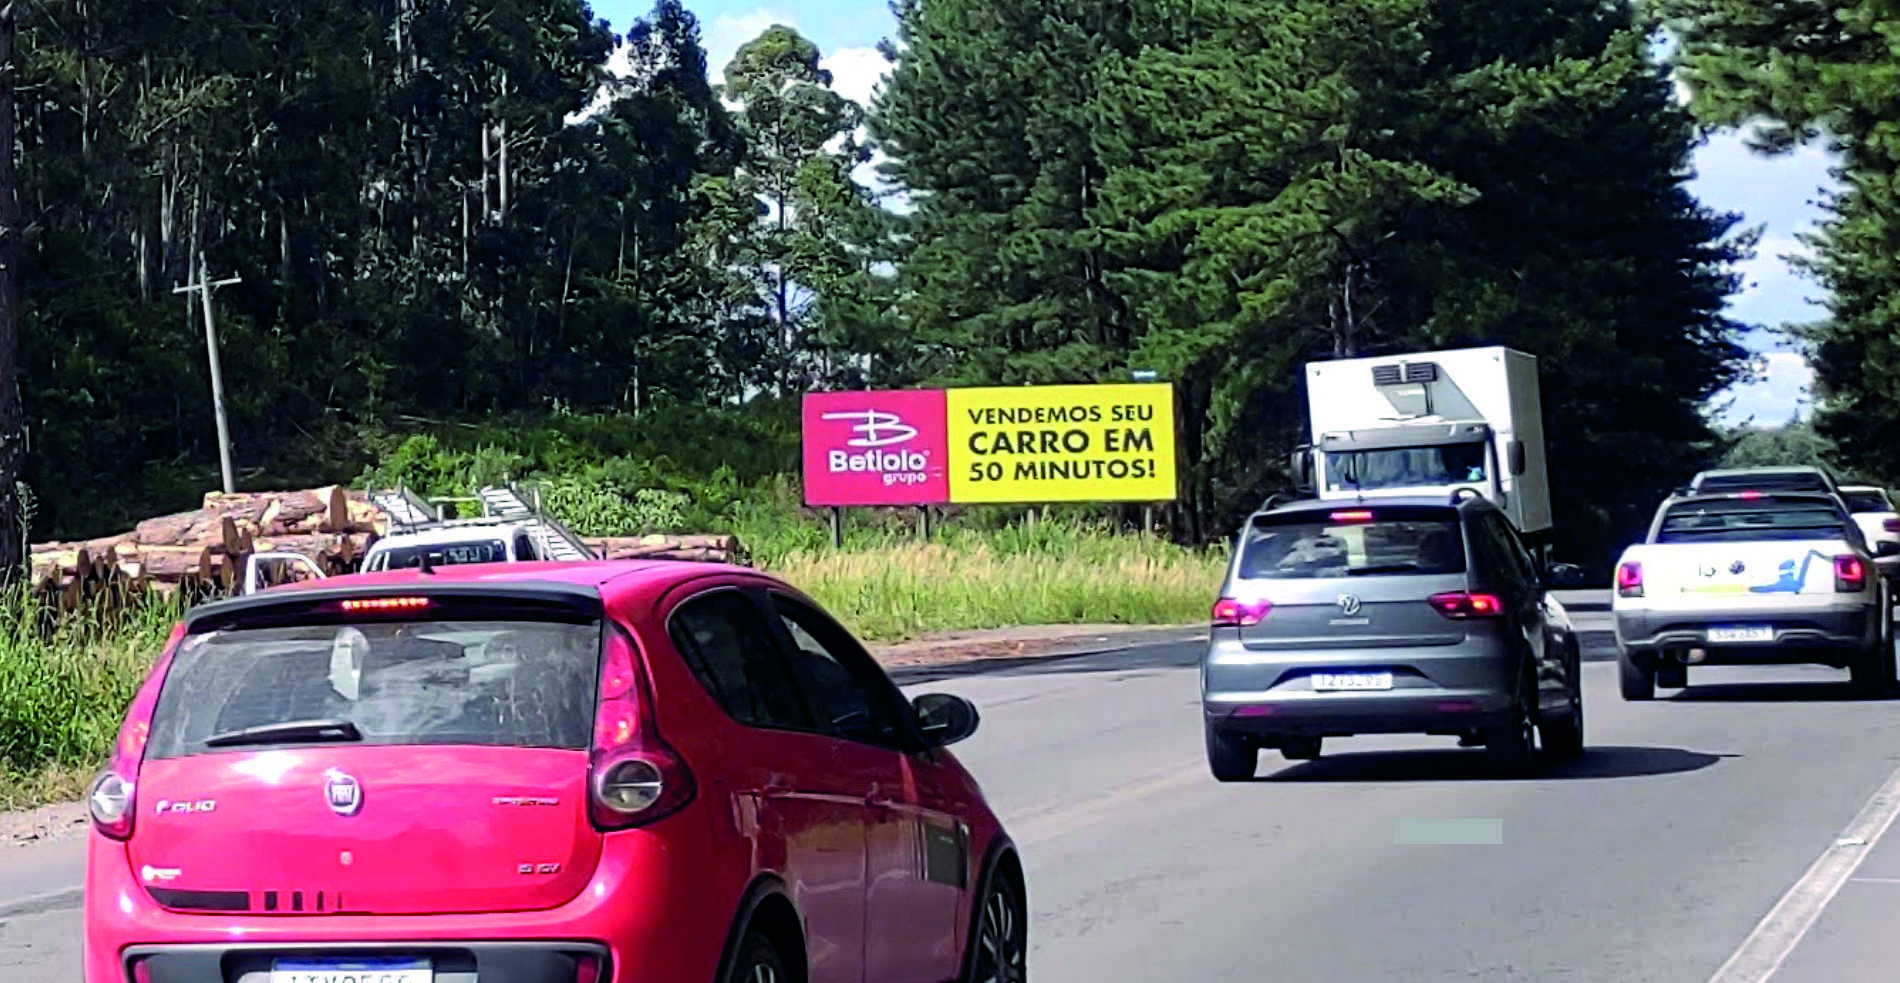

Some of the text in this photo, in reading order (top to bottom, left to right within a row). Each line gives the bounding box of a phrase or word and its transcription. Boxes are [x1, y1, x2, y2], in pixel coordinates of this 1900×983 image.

[968, 405, 1153, 424] VENDEMOS SEU
[968, 428, 1154, 455] CARRO EM
[882, 472, 927, 486] grupo
[969, 459, 1155, 481] 50 MINUTOS!
